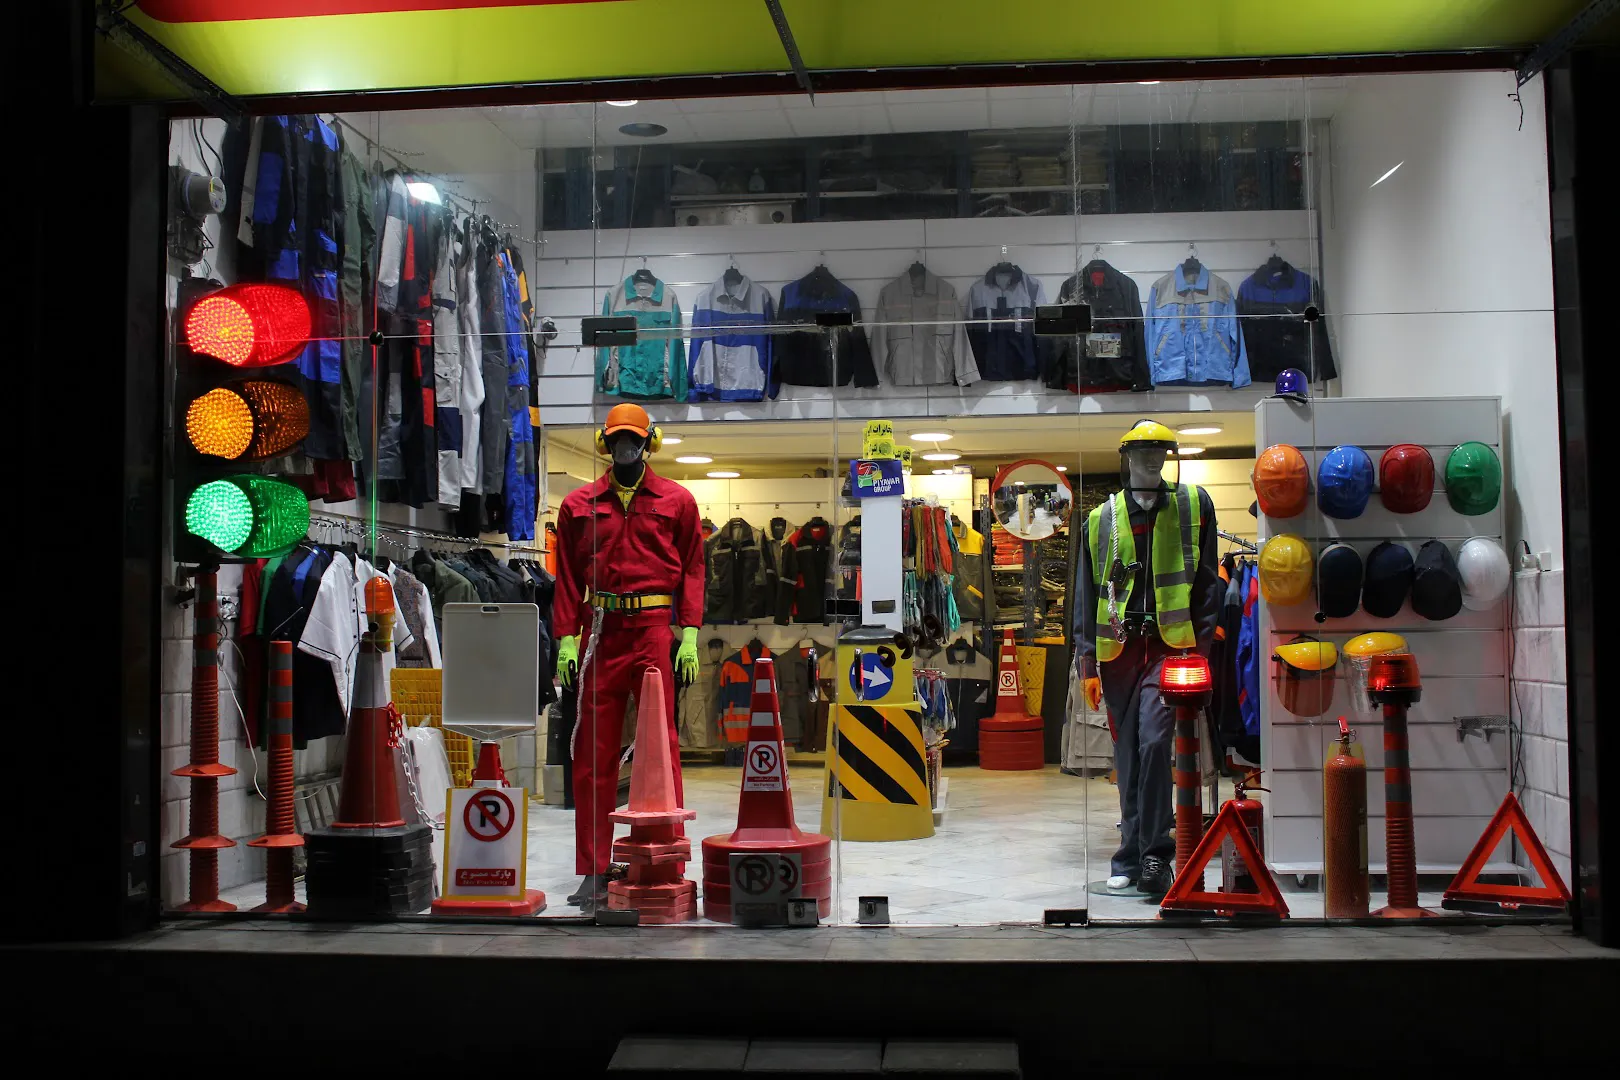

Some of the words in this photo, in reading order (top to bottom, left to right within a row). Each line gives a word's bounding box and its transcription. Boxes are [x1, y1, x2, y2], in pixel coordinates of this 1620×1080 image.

[758, 751, 770, 768] P
[480, 800, 500, 827] P
[490, 870, 512, 880] پارک
